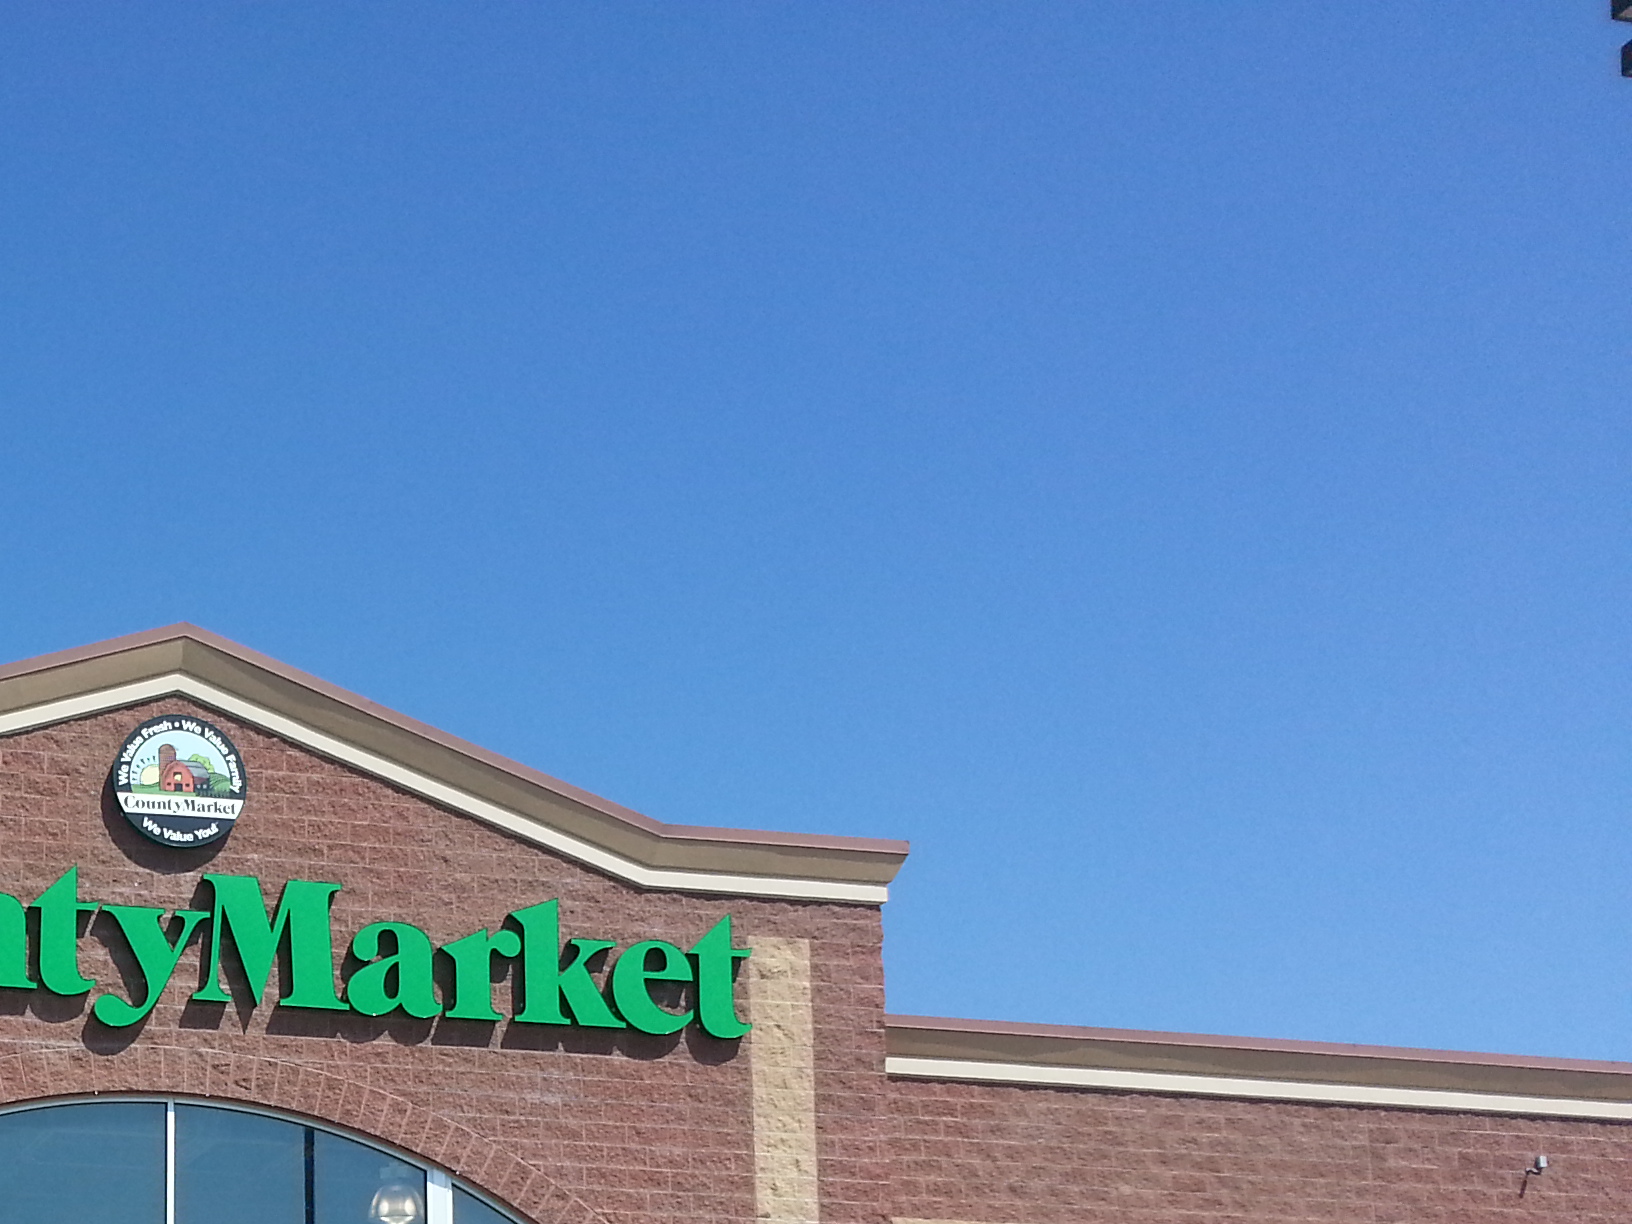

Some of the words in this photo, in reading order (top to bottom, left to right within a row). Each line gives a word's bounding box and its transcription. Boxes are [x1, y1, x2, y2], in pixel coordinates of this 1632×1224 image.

[140, 720, 173, 740] Fresh
[120, 735, 143, 762] Value
[181, 719, 202, 734] We
[203, 727, 229, 755] Value
[224, 753, 244, 794] Family
[117, 763, 130, 786] We
[123, 794, 237, 816] CountyMarket
[142, 816, 161, 836] We
[161, 828, 194, 843] Value
